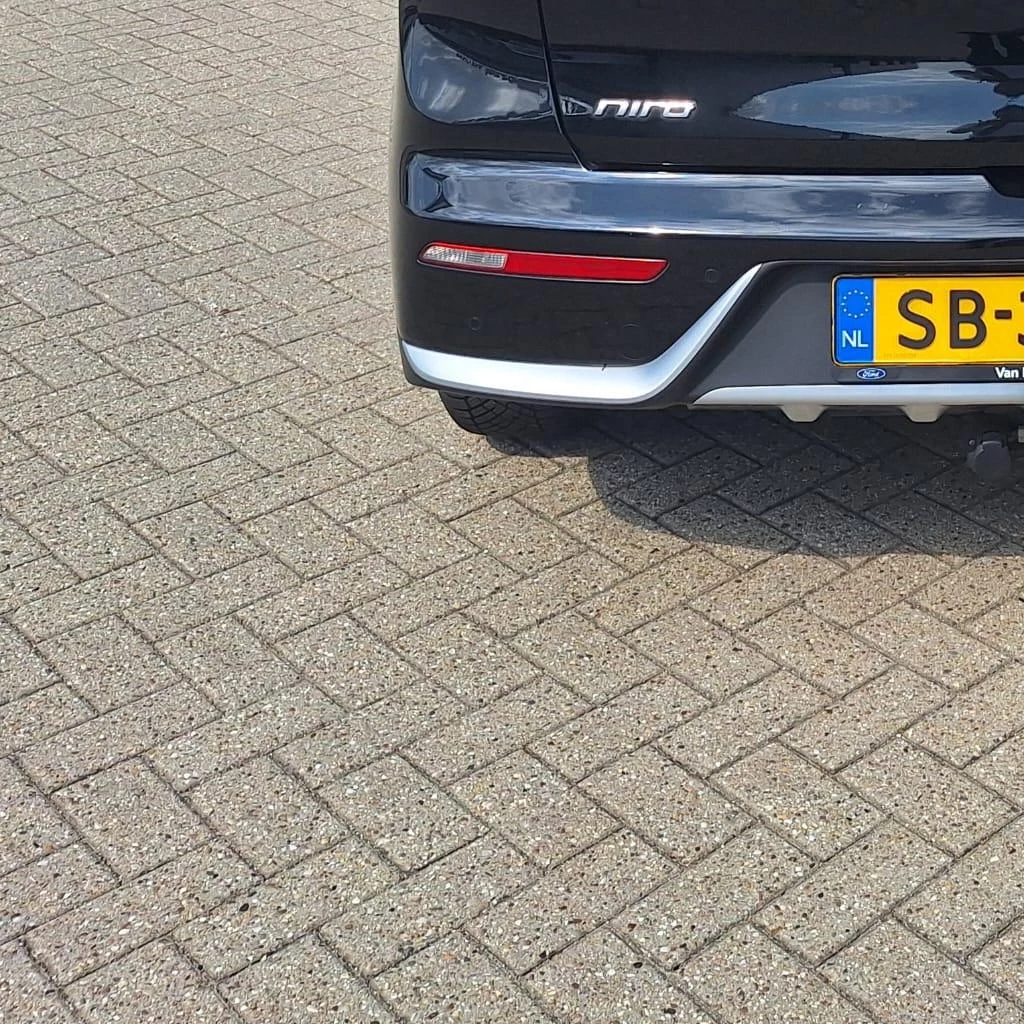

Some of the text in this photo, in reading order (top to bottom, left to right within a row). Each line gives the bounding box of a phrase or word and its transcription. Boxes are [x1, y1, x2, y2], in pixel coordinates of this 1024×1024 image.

[841, 329, 869, 349] NL
[860, 368, 882, 378] Ford
[995, 366, 1019, 378] Van
